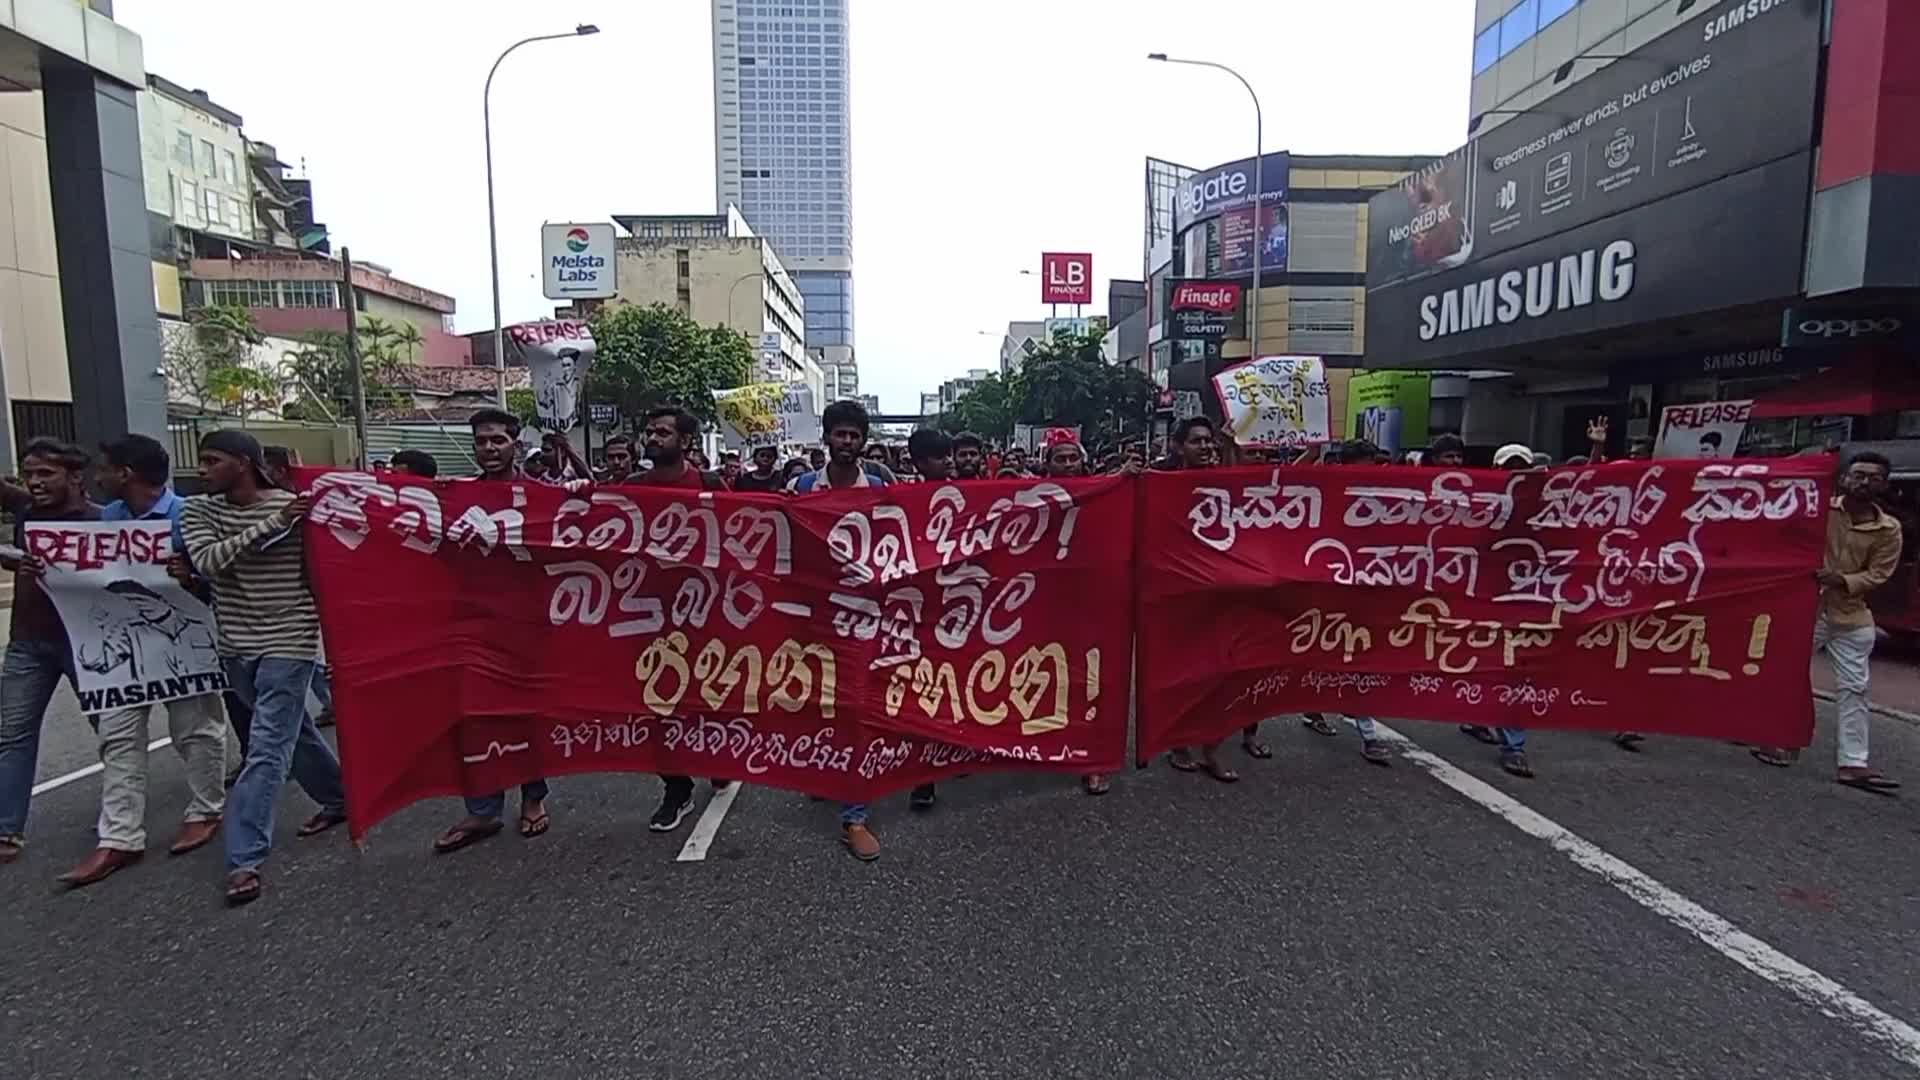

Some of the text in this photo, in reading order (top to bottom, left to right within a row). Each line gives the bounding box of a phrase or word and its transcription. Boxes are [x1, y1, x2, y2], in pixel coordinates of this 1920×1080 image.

[1703, 0, 1787, 41] SAMSU
[1493, 136, 1547, 171] Greatness
[1548, 118, 1582, 145] never
[1623, 86, 1647, 109] but
[1650, 54, 1711, 94] evolves
[1410, 209, 1437, 235] QLED
[552, 255, 604, 268] Melsta
[1050, 261, 1085, 285] LB
[558, 268, 597, 282] Labs
[1180, 288, 1232, 307] Finagle
[1418, 240, 1636, 341] SAMSUNG
[511, 322, 593, 347] RELEASE
[1703, 348, 1784, 371] SAMSUNG
[1664, 404, 1752, 429] RELEASE
[26, 529, 172, 571] RELEASE
